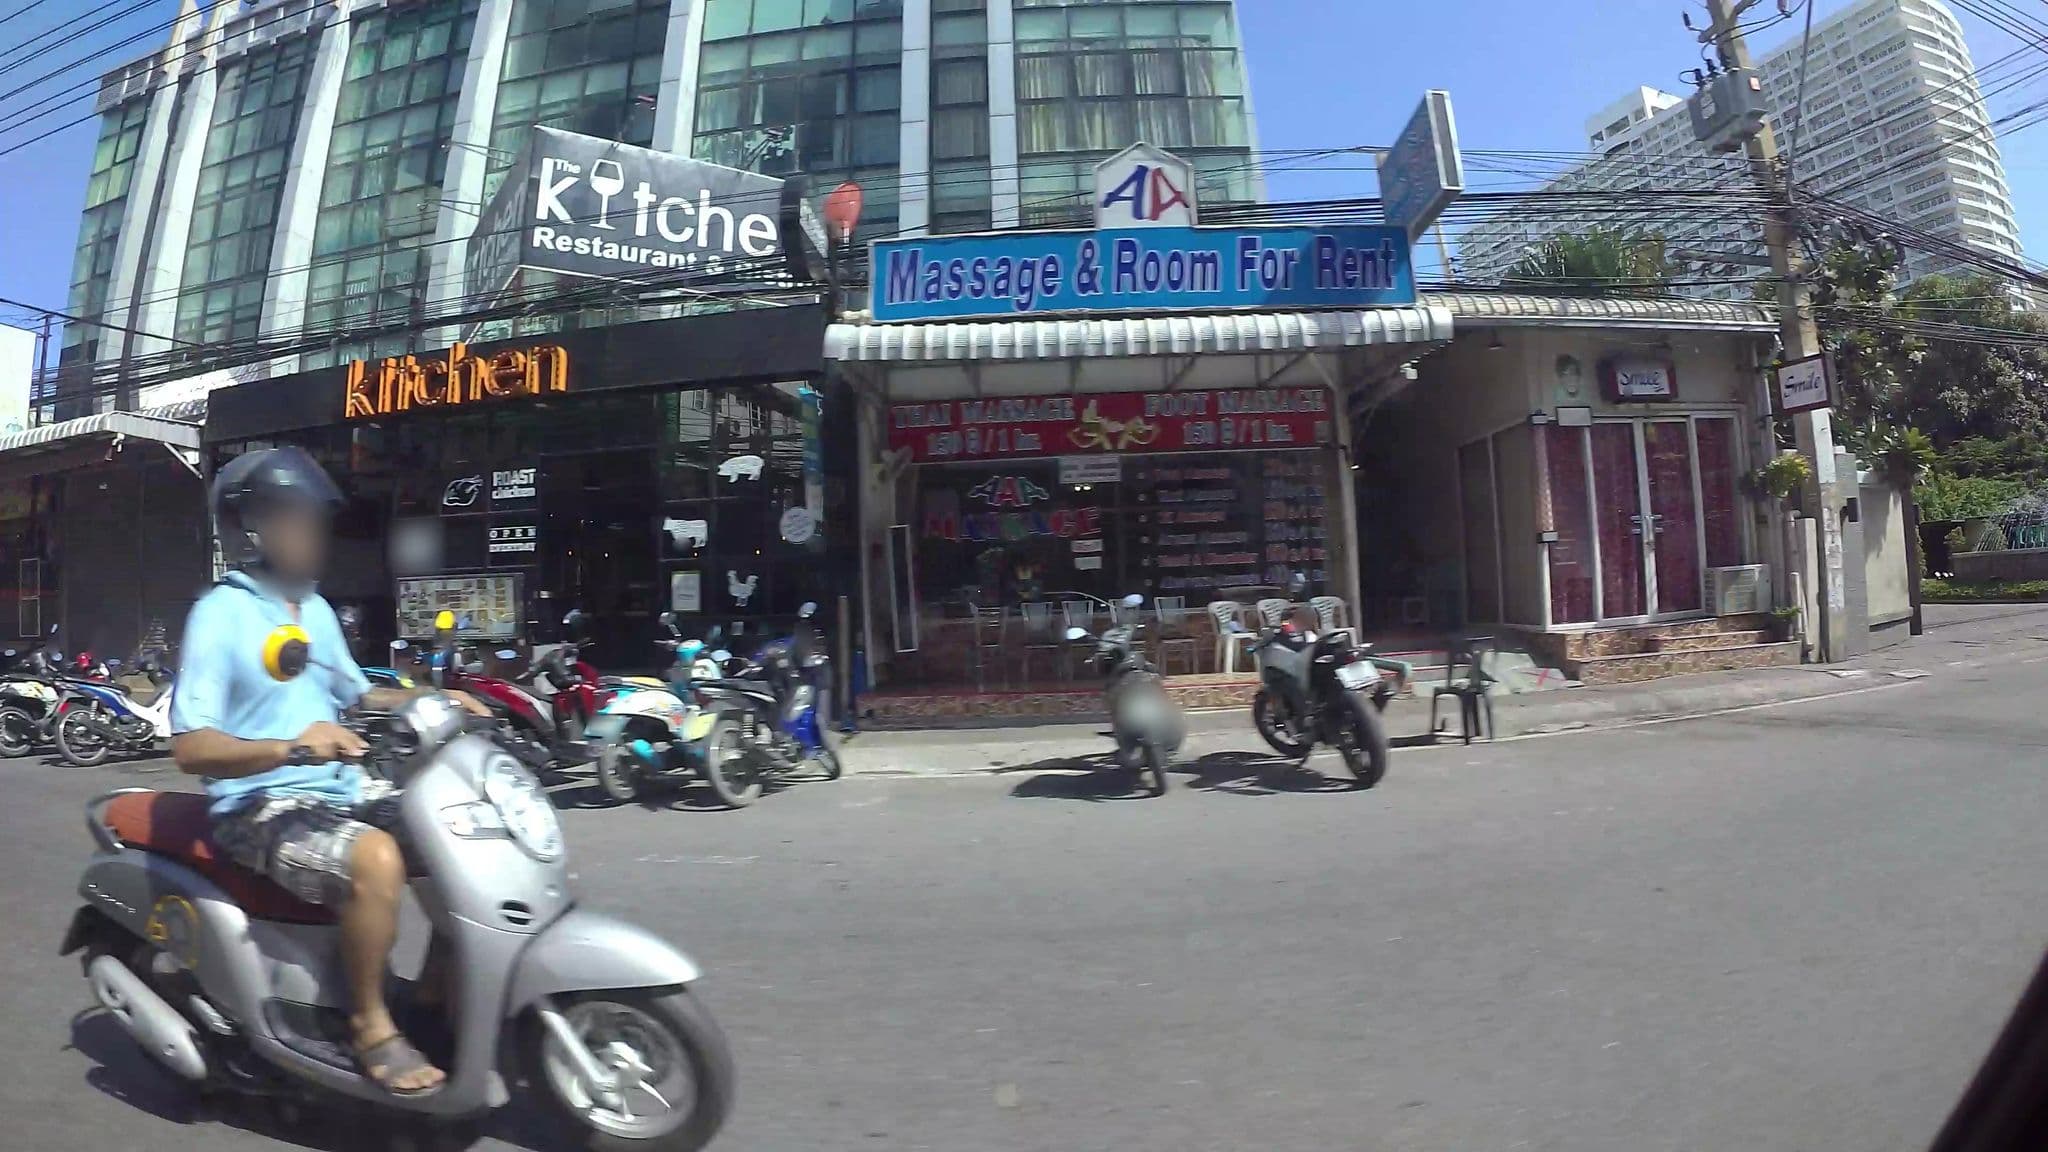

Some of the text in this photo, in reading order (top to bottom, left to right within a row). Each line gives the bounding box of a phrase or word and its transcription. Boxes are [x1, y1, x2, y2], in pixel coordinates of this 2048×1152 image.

[555, 158, 581, 175] The
[532, 226, 698, 271] Restaurant
[886, 234, 1397, 313] Massage & Room For Rent
[345, 341, 569, 418] kitchen
[1783, 373, 1822, 399] Smile
[893, 396, 1075, 429] THAI MASSAGE
[1143, 389, 1327, 418] FOOT MASSAGE
[491, 467, 537, 487] ROAST
[489, 528, 537, 539] OPEN
